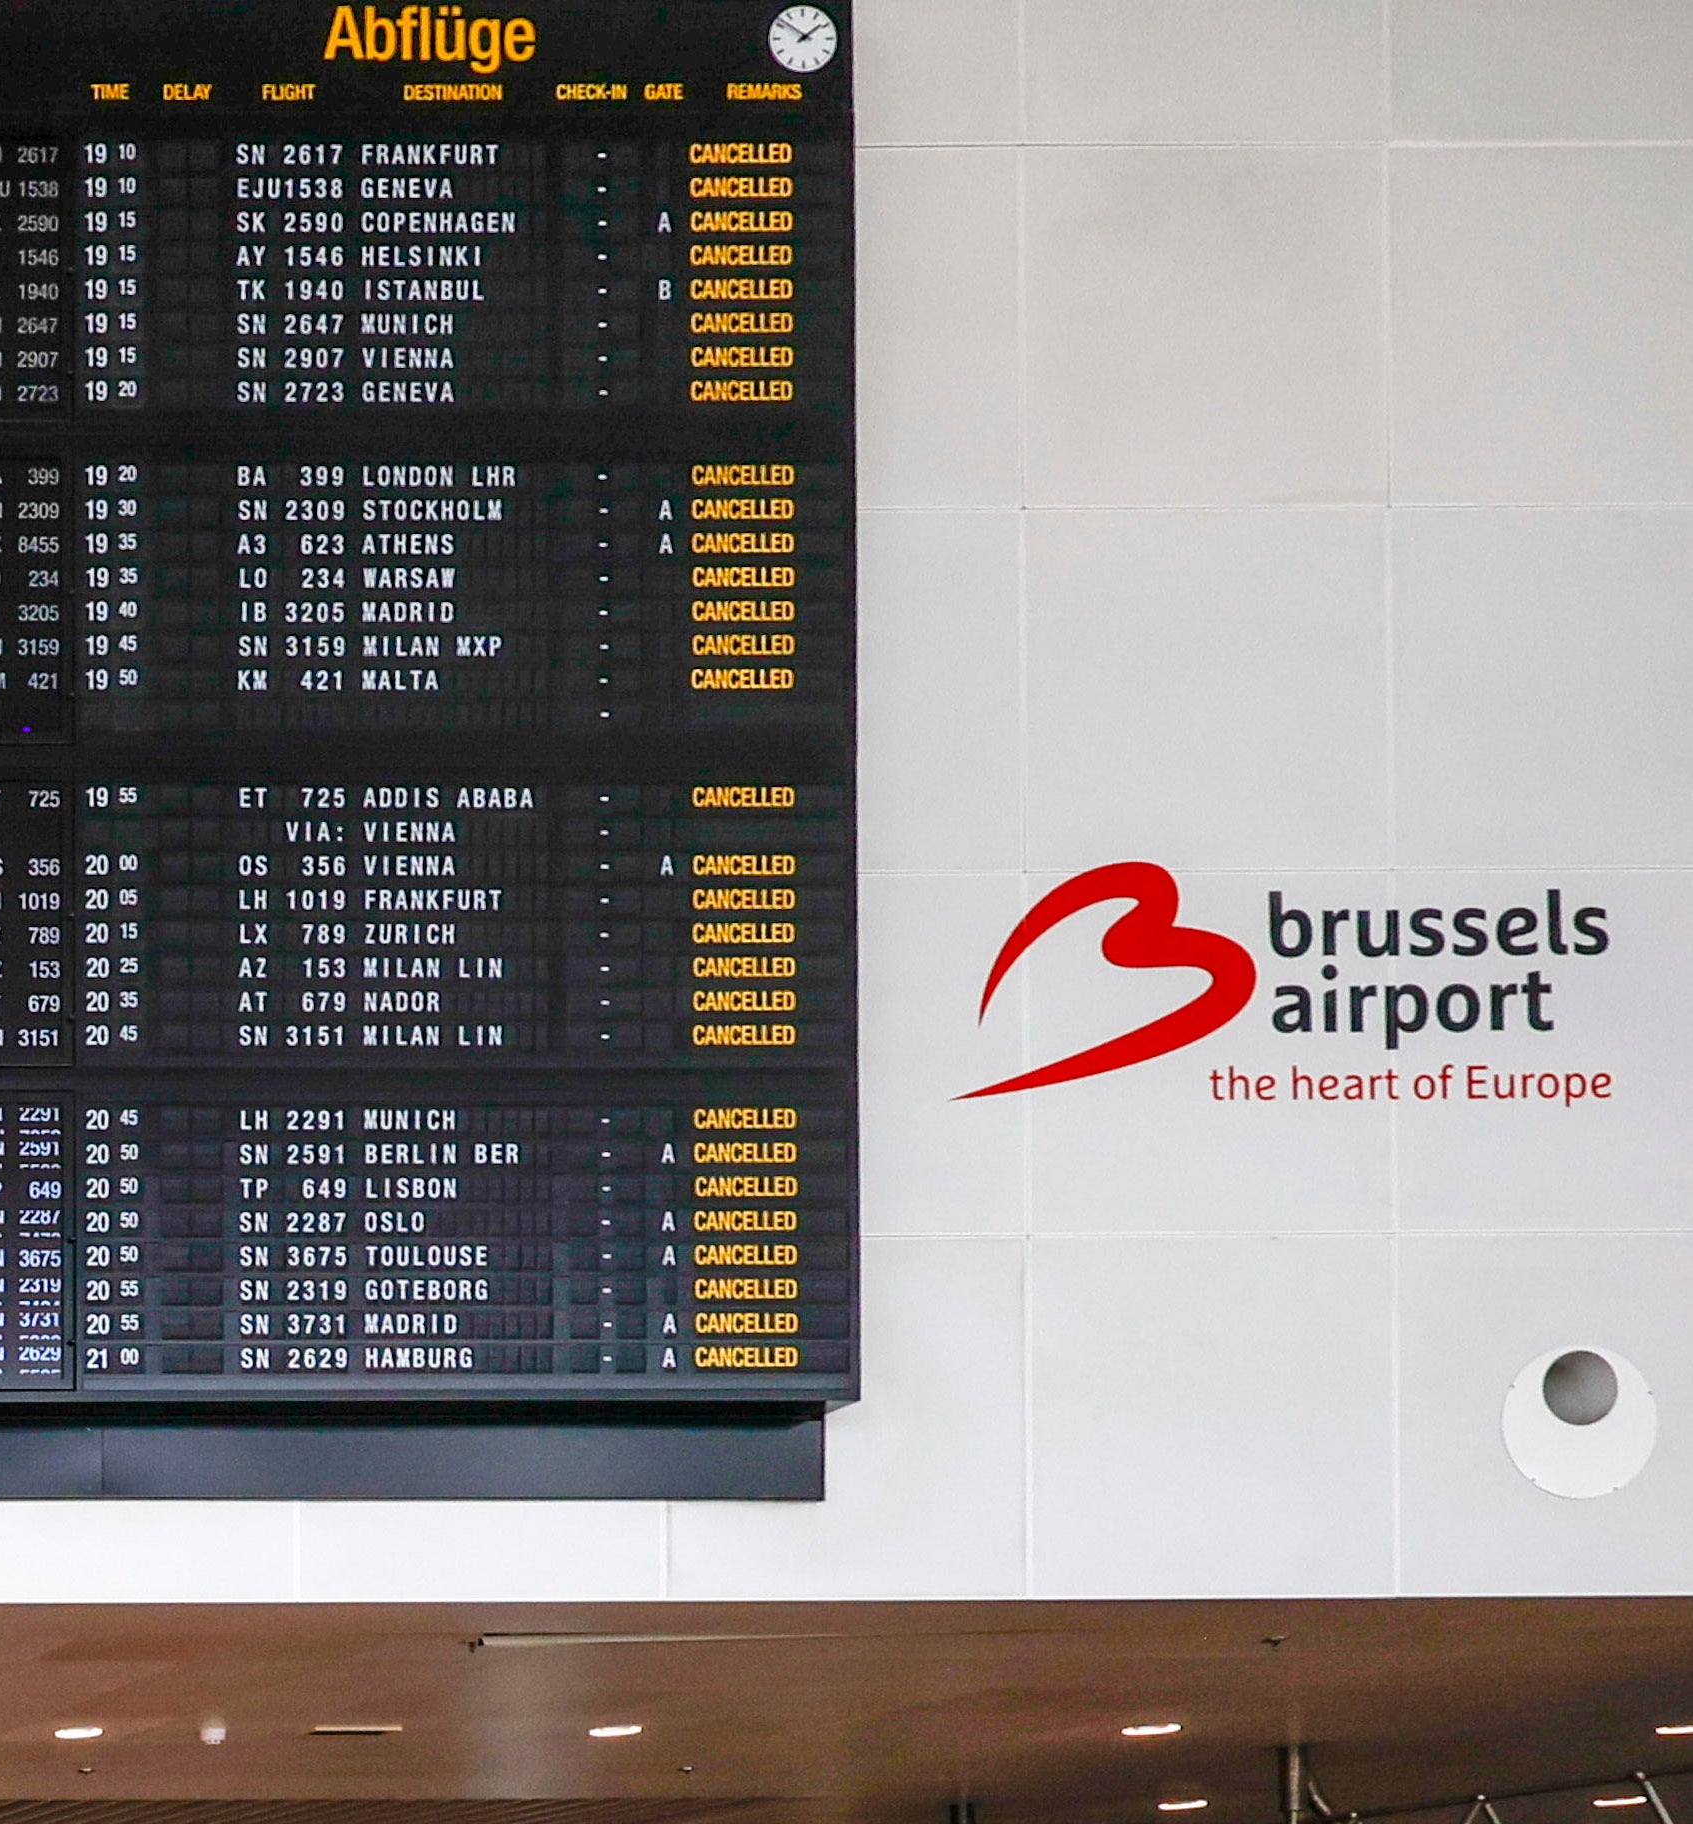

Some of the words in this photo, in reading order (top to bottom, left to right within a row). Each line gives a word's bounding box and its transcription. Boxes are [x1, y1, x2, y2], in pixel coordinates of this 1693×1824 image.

[324, 5, 535, 74] Abflüge
[91, 84, 129, 99] TIME
[163, 84, 212, 100] DELAY
[262, 84, 315, 100] FLIGHT
[404, 84, 502, 100] DESTINATION
[556, 84, 627, 100] CHECK-IN
[644, 83, 683, 100] GATE
[727, 83, 802, 100] REMARKS
[235, 143, 266, 166] SN
[283, 143, 343, 166] 2617
[361, 143, 499, 166] FRANKFURT
[689, 142, 793, 165] CANCELLED
[236, 279, 265, 301] TK
[284, 279, 344, 301] 1940
[365, 279, 485, 301] ISTANBUL
[689, 278, 794, 301] CANCELLED
[237, 465, 267, 487] BA
[300, 465, 344, 487] 399
[362, 465, 454, 488] LONDON
[471, 465, 516, 487] LHR
[691, 464, 795, 487] CANCELLED
[238, 787, 268, 809] ET
[301, 787, 346, 809] 725
[362, 786, 440, 809] ADDIS
[456, 787, 533, 809] ABABA
[692, 786, 795, 808] CANCELLED
[239, 923, 268, 945] LX
[302, 923, 346, 945] 789
[364, 923, 455, 945] ZURICH
[692, 922, 796, 944] CANCELLED
[1269, 889, 1609, 958] brussels
[1272, 964, 1554, 1050] airport
[1210, 1066, 1275, 1100] the
[1293, 1066, 1399, 1100] heart
[1414, 1064, 1453, 1100] of
[1468, 1066, 1611, 1107] Europe
[239, 1245, 269, 1267] SN
[287, 1245, 347, 1267] 3675
[365, 1245, 488, 1267] TOULOUSE
[694, 1244, 798, 1266] CANCELLED
